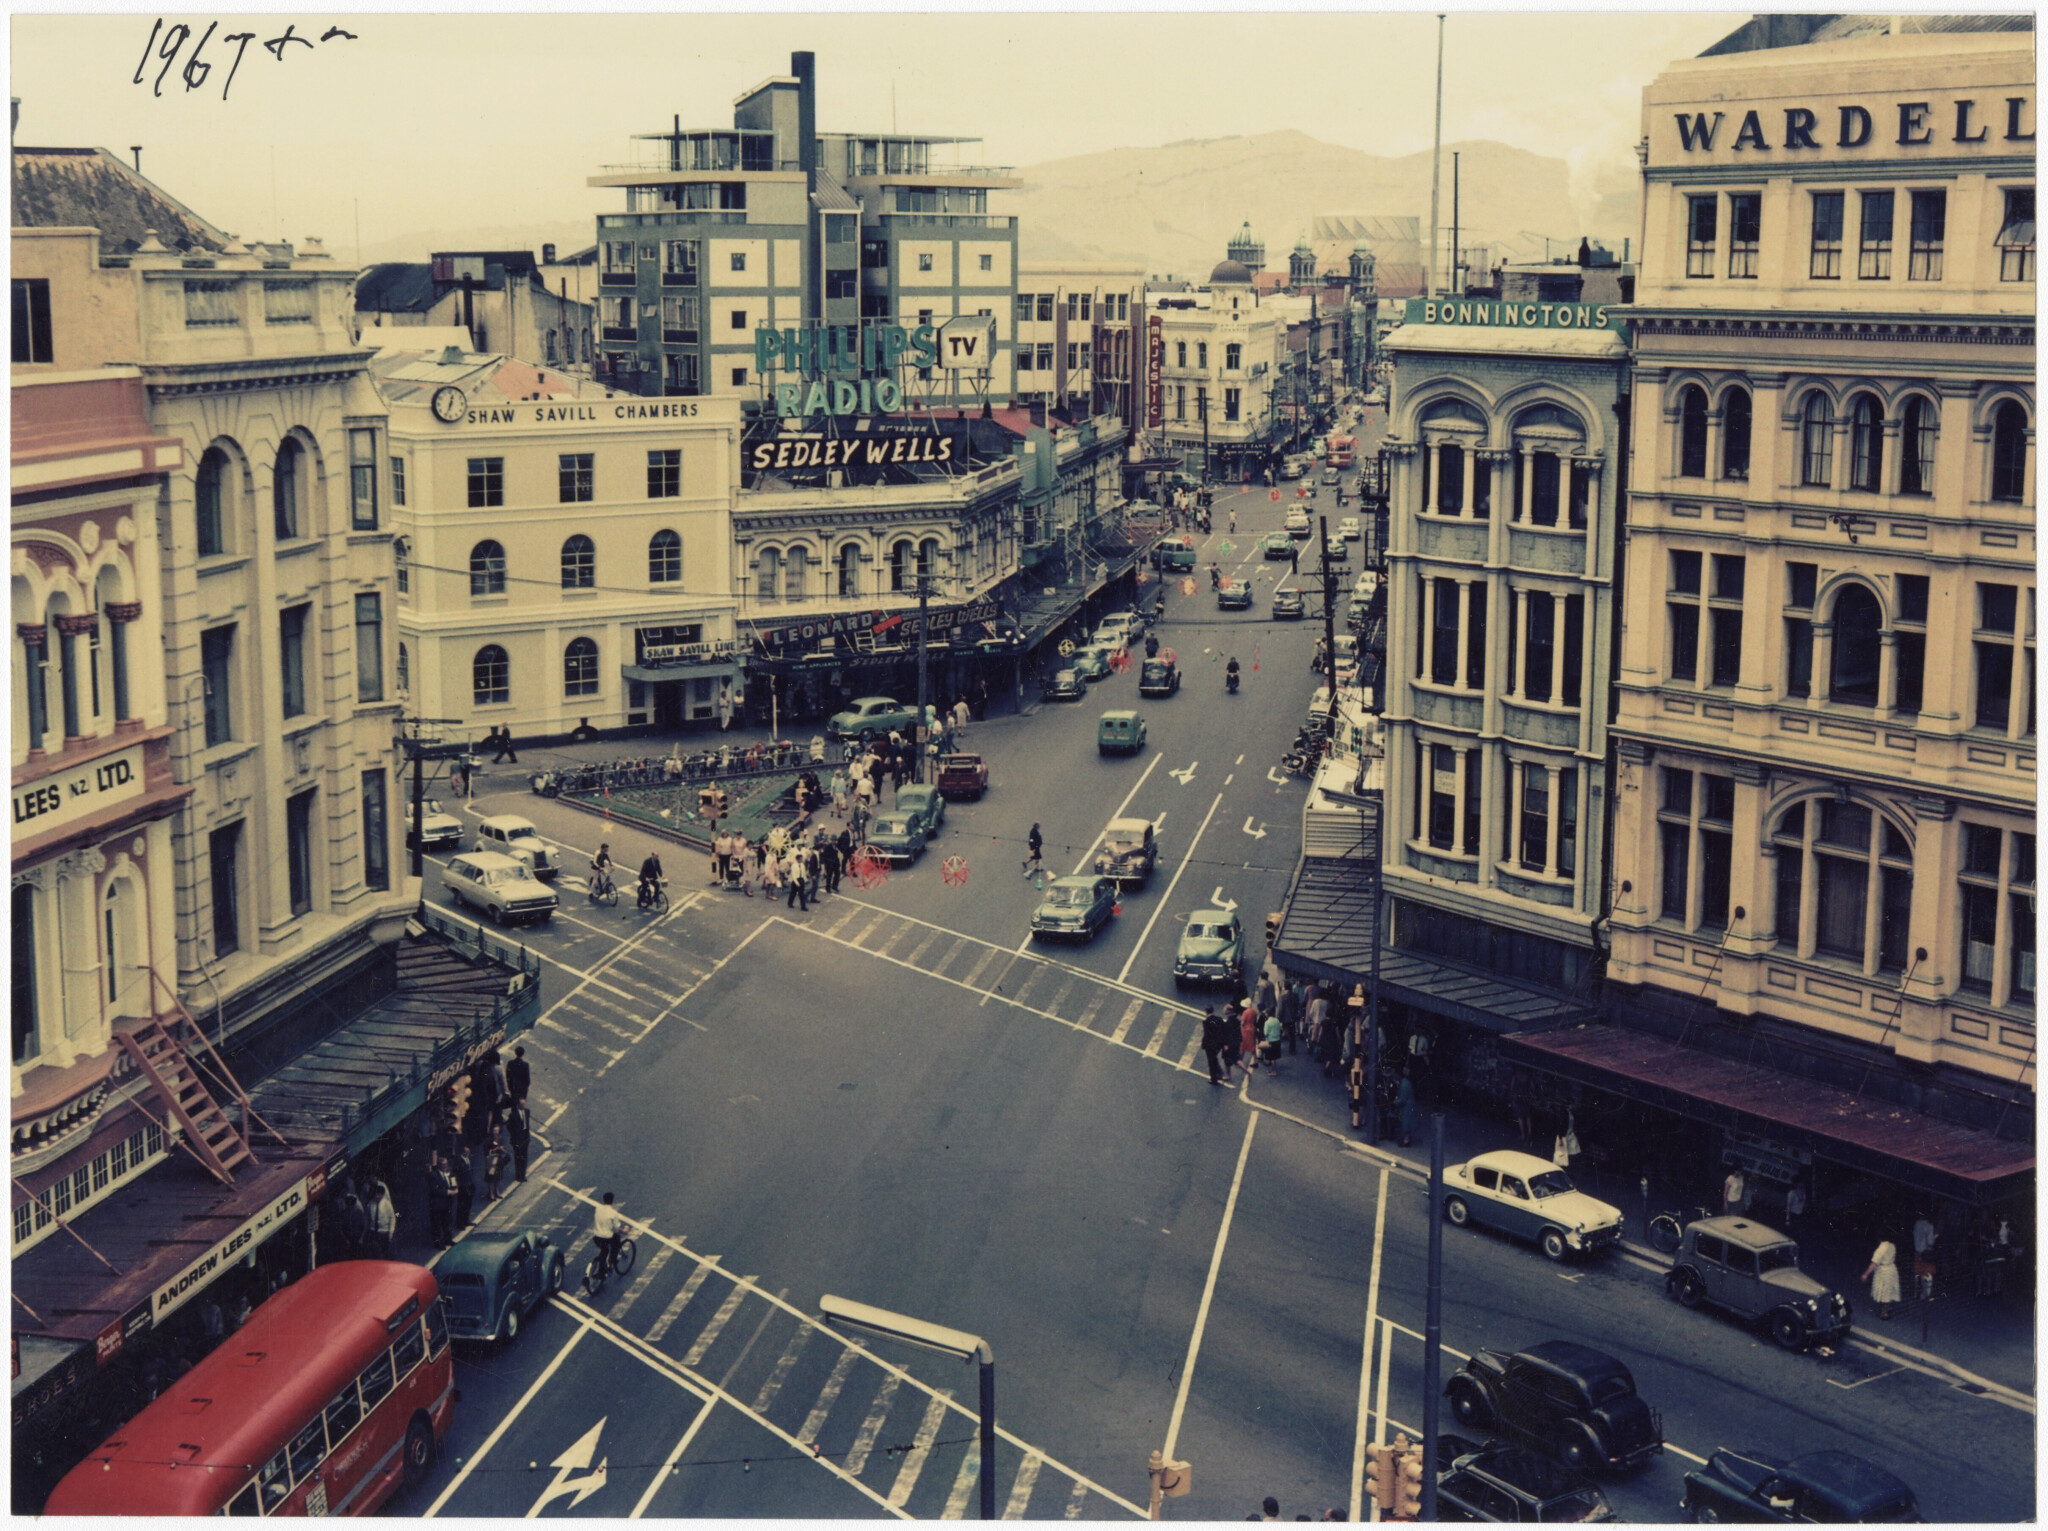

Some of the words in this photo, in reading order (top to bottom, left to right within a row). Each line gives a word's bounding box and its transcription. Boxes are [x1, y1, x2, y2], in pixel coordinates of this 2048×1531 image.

[132, 17, 256, 101] 1967
[1674, 97, 2036, 151] WARDELL
[1424, 302, 1609, 328] BONNINGTONS
[754, 325, 938, 374] PHILIPS
[948, 336, 978, 357] TV
[1150, 325, 1160, 415] MAJESTIC
[468, 409, 515, 424] SHAW
[535, 407, 597, 421] SAVILL
[615, 403, 698, 419] CHAMBERS
[777, 378, 902, 417] RADIO
[753, 439, 860, 469] SEDLEY
[866, 437, 953, 464] WELLS
[773, 613, 874, 645] LEONARD
[900, 617, 953, 637] SEDLEY
[957, 606, 998, 625] WELLS
[646, 648, 674, 658] SHAW
[678, 643, 711, 656] SAVILL
[715, 641, 736, 652] LINE
[850, 656, 900, 668] SEDLEY
[903, 653, 946, 664] WLLS
[13, 784, 60, 824] LEES
[97, 759, 135, 792] LTD.
[158, 1253, 219, 1310] ANDREW
[222, 1228, 252, 1260] LEES
[275, 1191, 302, 1218] LTD.
